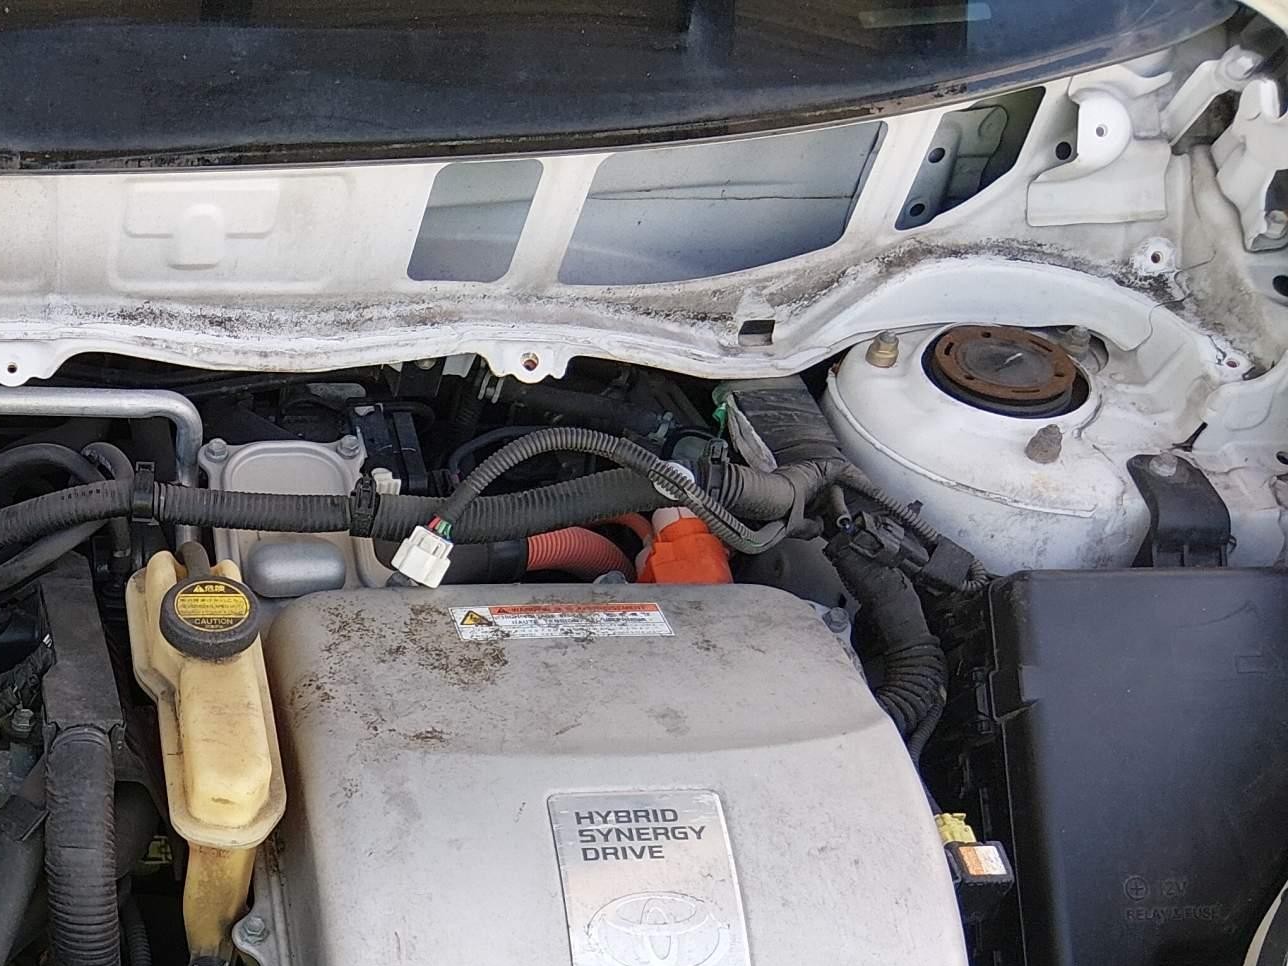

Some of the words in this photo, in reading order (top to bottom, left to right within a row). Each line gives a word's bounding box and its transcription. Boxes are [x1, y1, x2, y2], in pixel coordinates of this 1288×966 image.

[575, 808, 679, 825] HYBRID
[578, 826, 706, 843] SYNERGY
[582, 845, 665, 862] DRIVE
